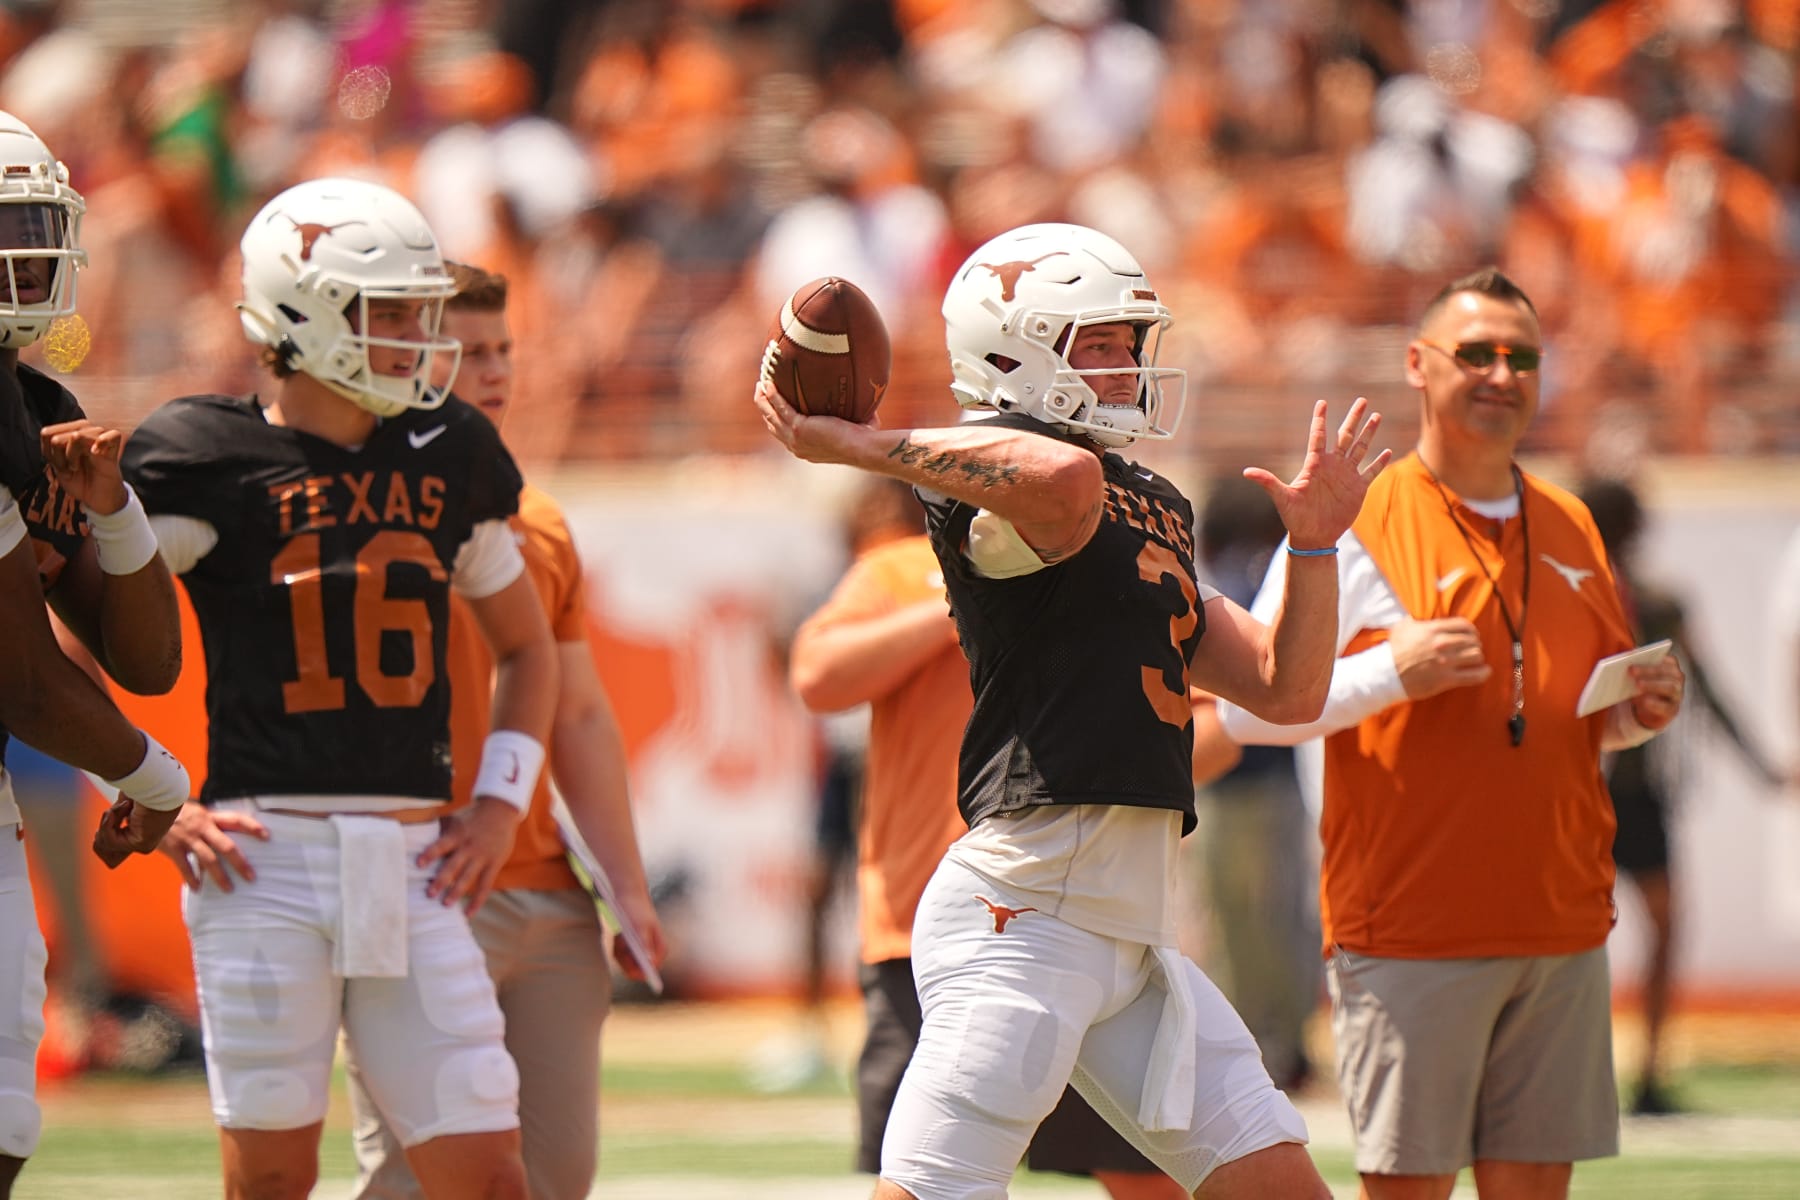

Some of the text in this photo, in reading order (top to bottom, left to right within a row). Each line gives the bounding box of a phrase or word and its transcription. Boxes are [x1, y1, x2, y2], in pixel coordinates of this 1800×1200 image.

[268, 470, 446, 534] TEXAS
[270, 529, 449, 715] 16
[1135, 539, 1198, 731] 3
